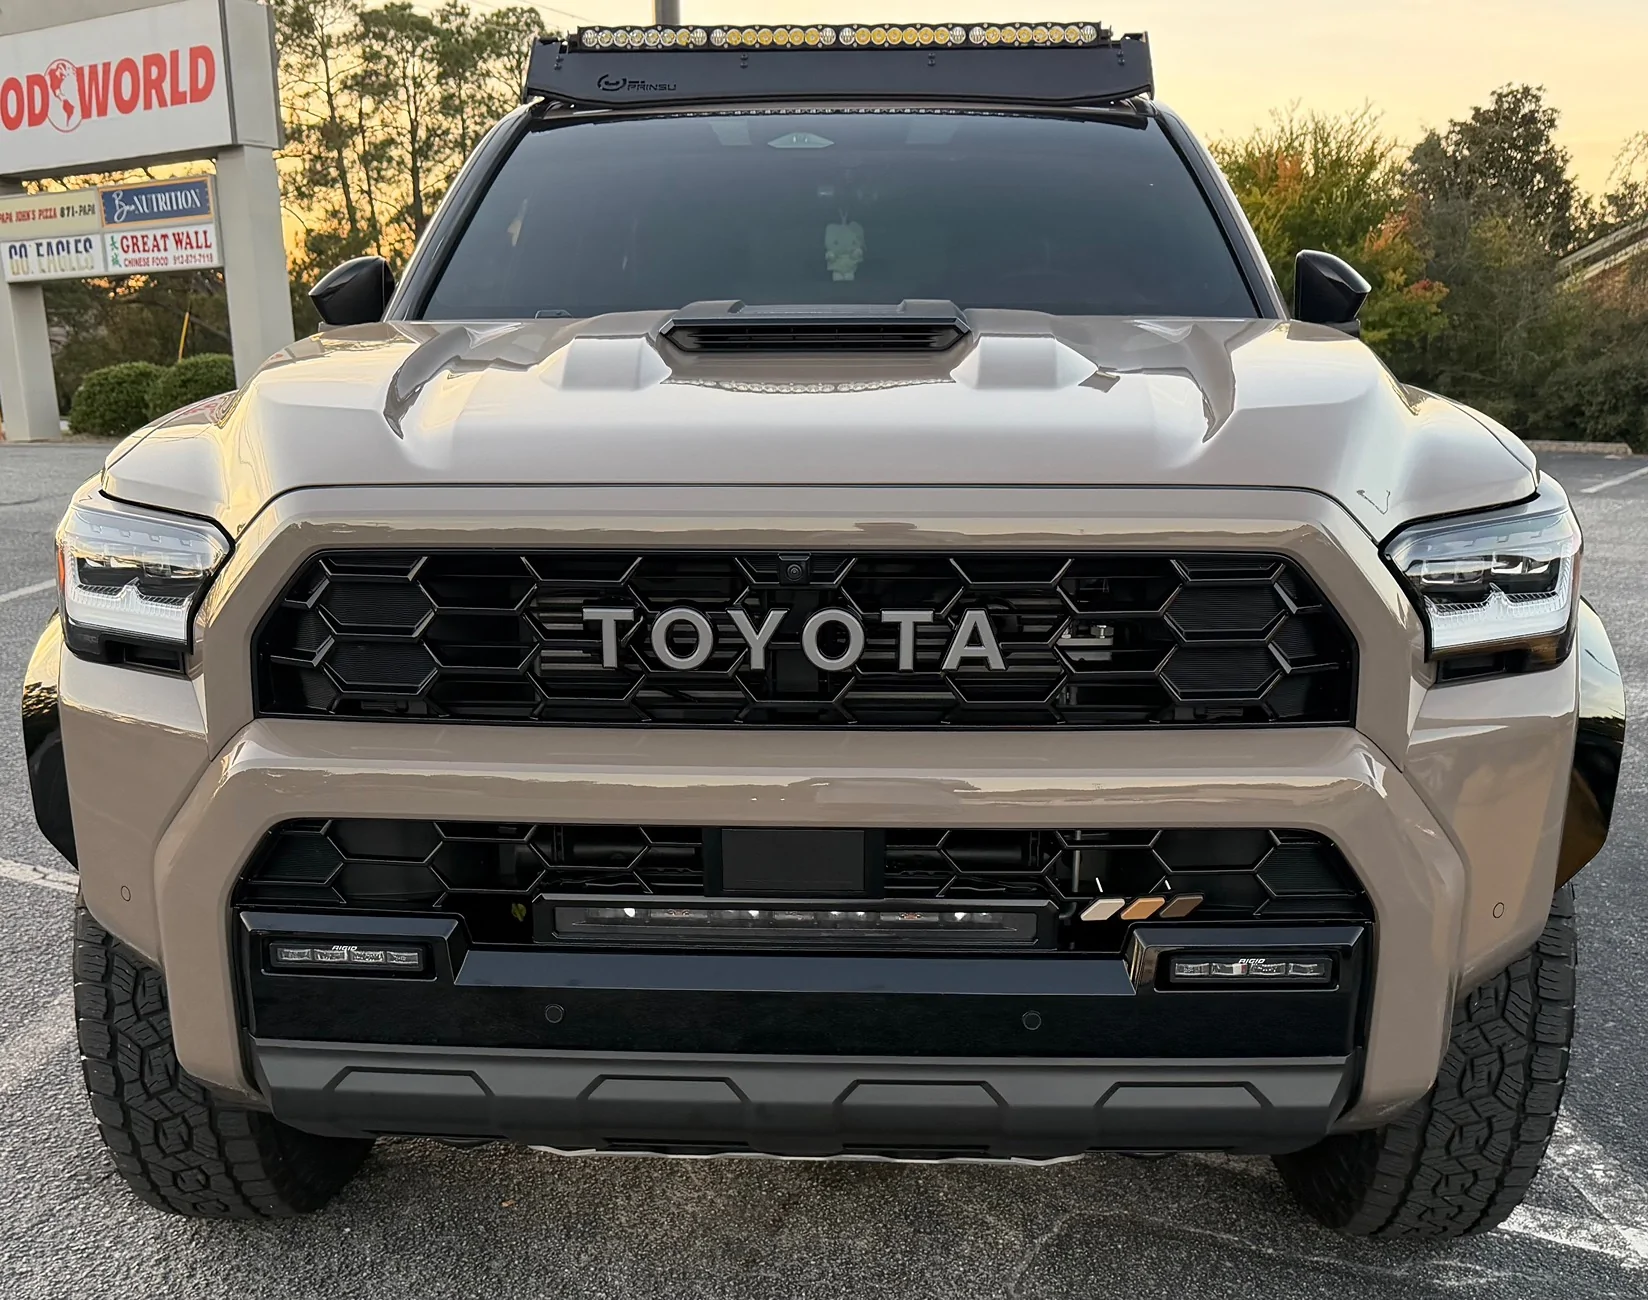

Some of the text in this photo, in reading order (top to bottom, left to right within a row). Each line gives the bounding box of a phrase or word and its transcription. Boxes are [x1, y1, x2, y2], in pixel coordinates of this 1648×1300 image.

[76, 45, 216, 120] WORLD
[627, 83, 677, 91] PRINSU
[15, 209, 36, 223] JOHN'S
[38, 207, 57, 220] PIZZA
[60, 203, 96, 218] 871-PAPA
[133, 188, 201, 214] NUTRITION
[121, 230, 212, 254] GREAT WALL
[35, 236, 94, 274] EAGLES
[124, 257, 150, 268] CHINESE
[152, 256, 168, 267] FOOD
[582, 606, 1008, 673] TOYOTA
